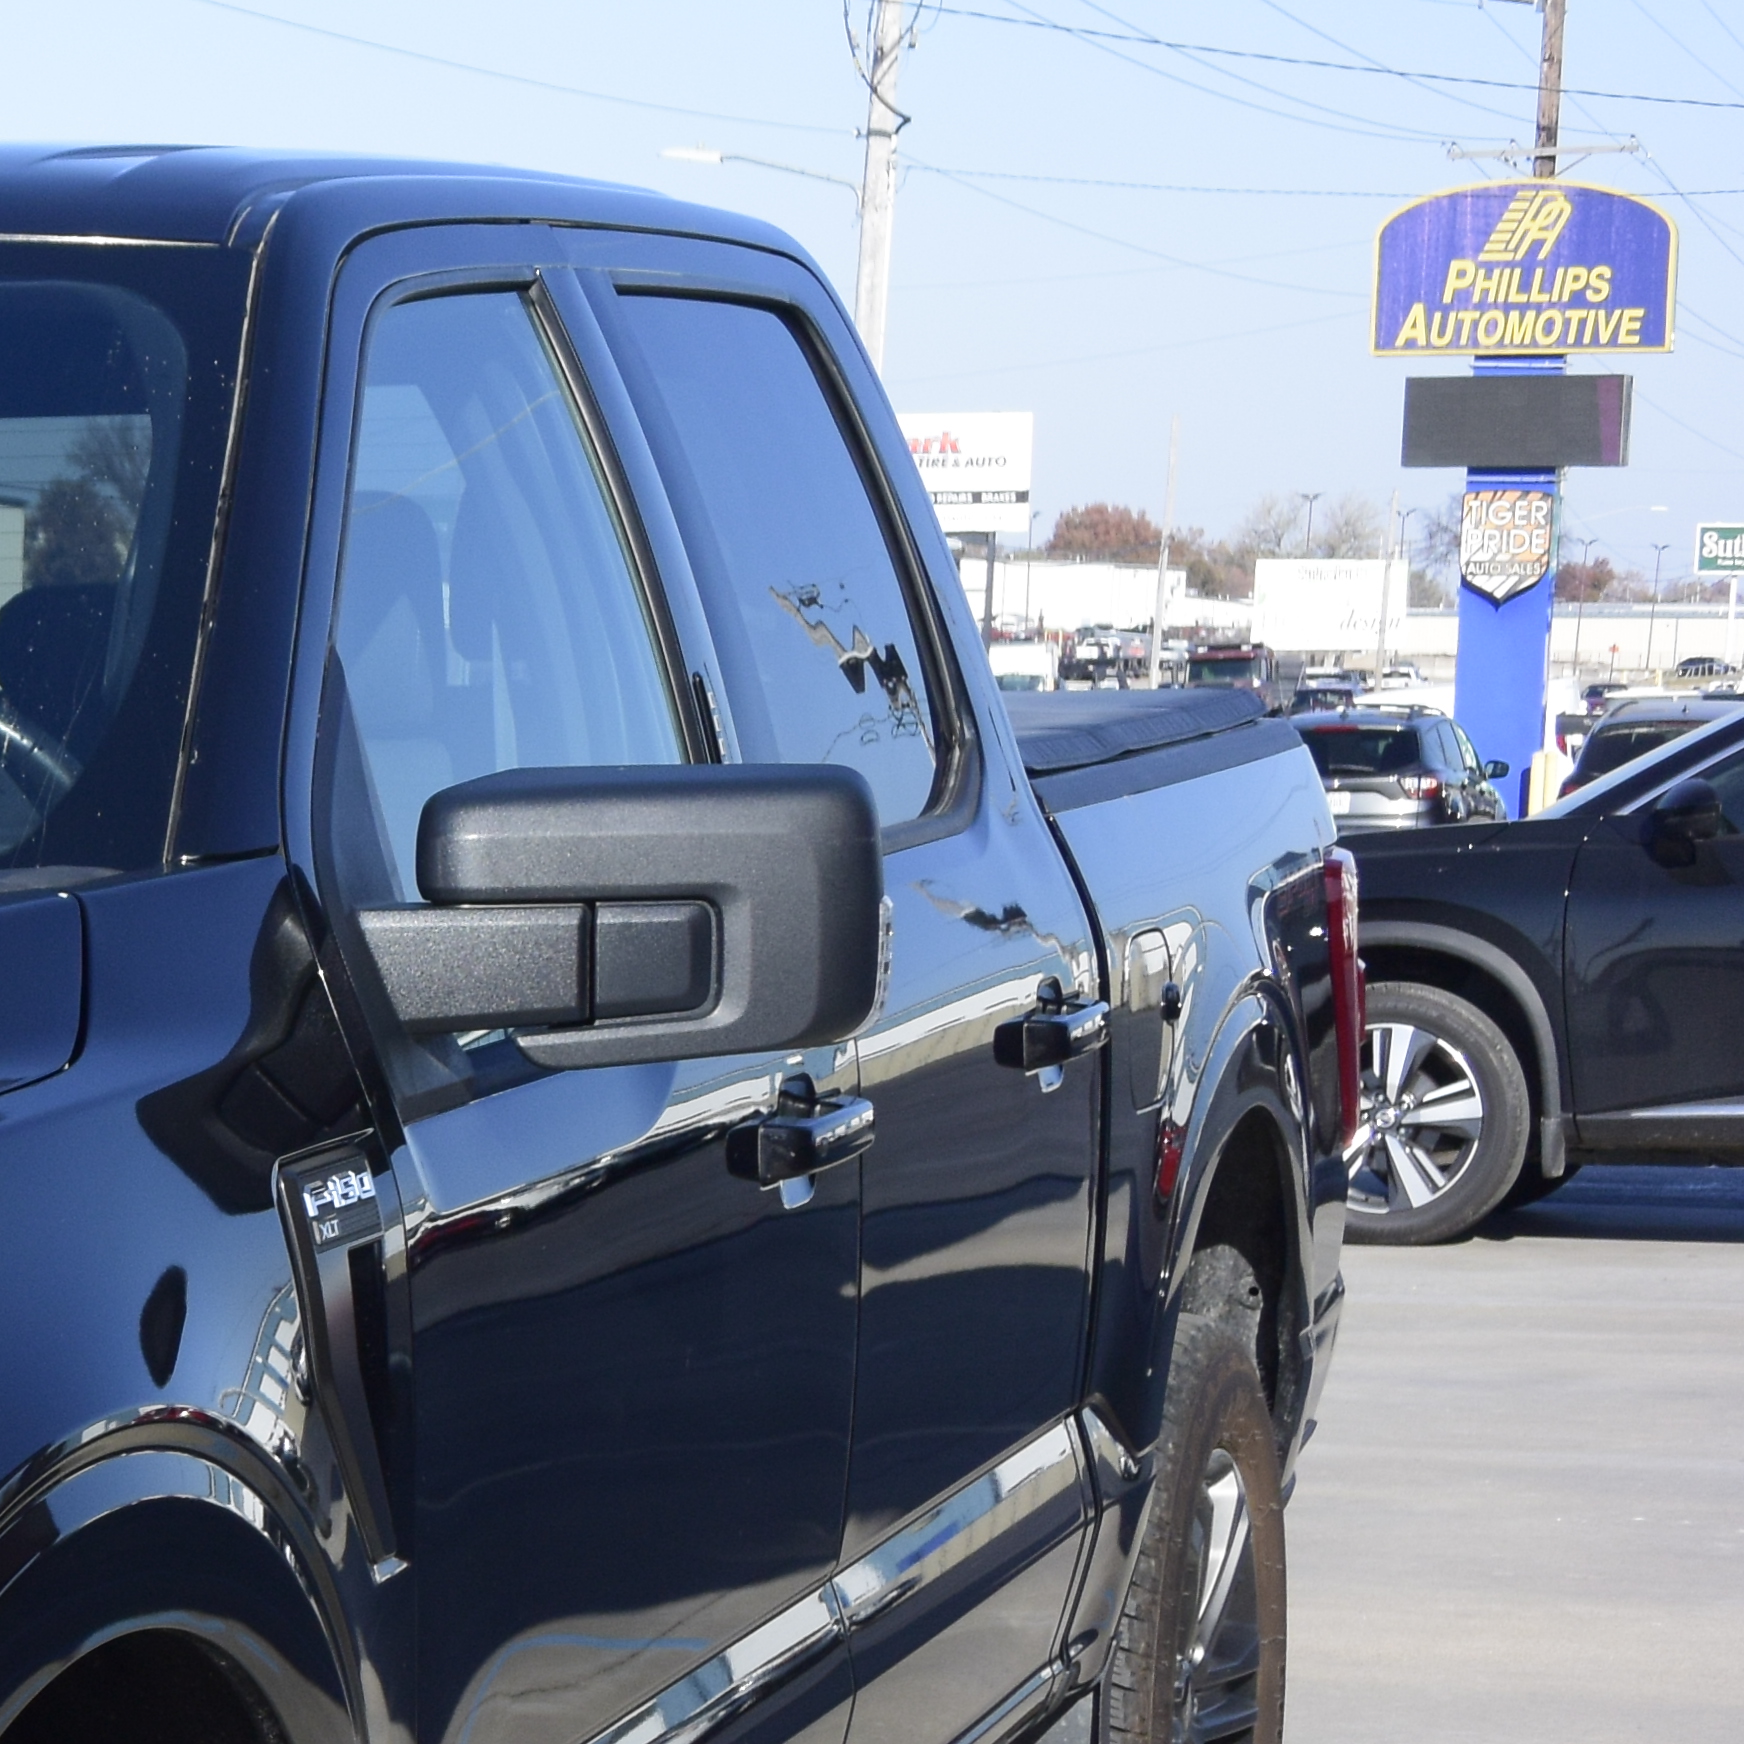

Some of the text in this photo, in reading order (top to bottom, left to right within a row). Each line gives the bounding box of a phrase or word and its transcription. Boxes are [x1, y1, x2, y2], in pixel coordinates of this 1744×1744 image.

[1442, 259, 1612, 304] PHILLIPS
[1394, 302, 1645, 347] AUTOMOTIVE
[918, 457, 948, 468] TIRE
[965, 456, 1007, 468] AUTO
[1468, 500, 1548, 526] TIGER
[1466, 529, 1546, 554] PRIDE
[1702, 530, 1744, 558] Sut
[1467, 562, 1541, 575] AUTO SALES
[318, 1219, 341, 1241] XLT
